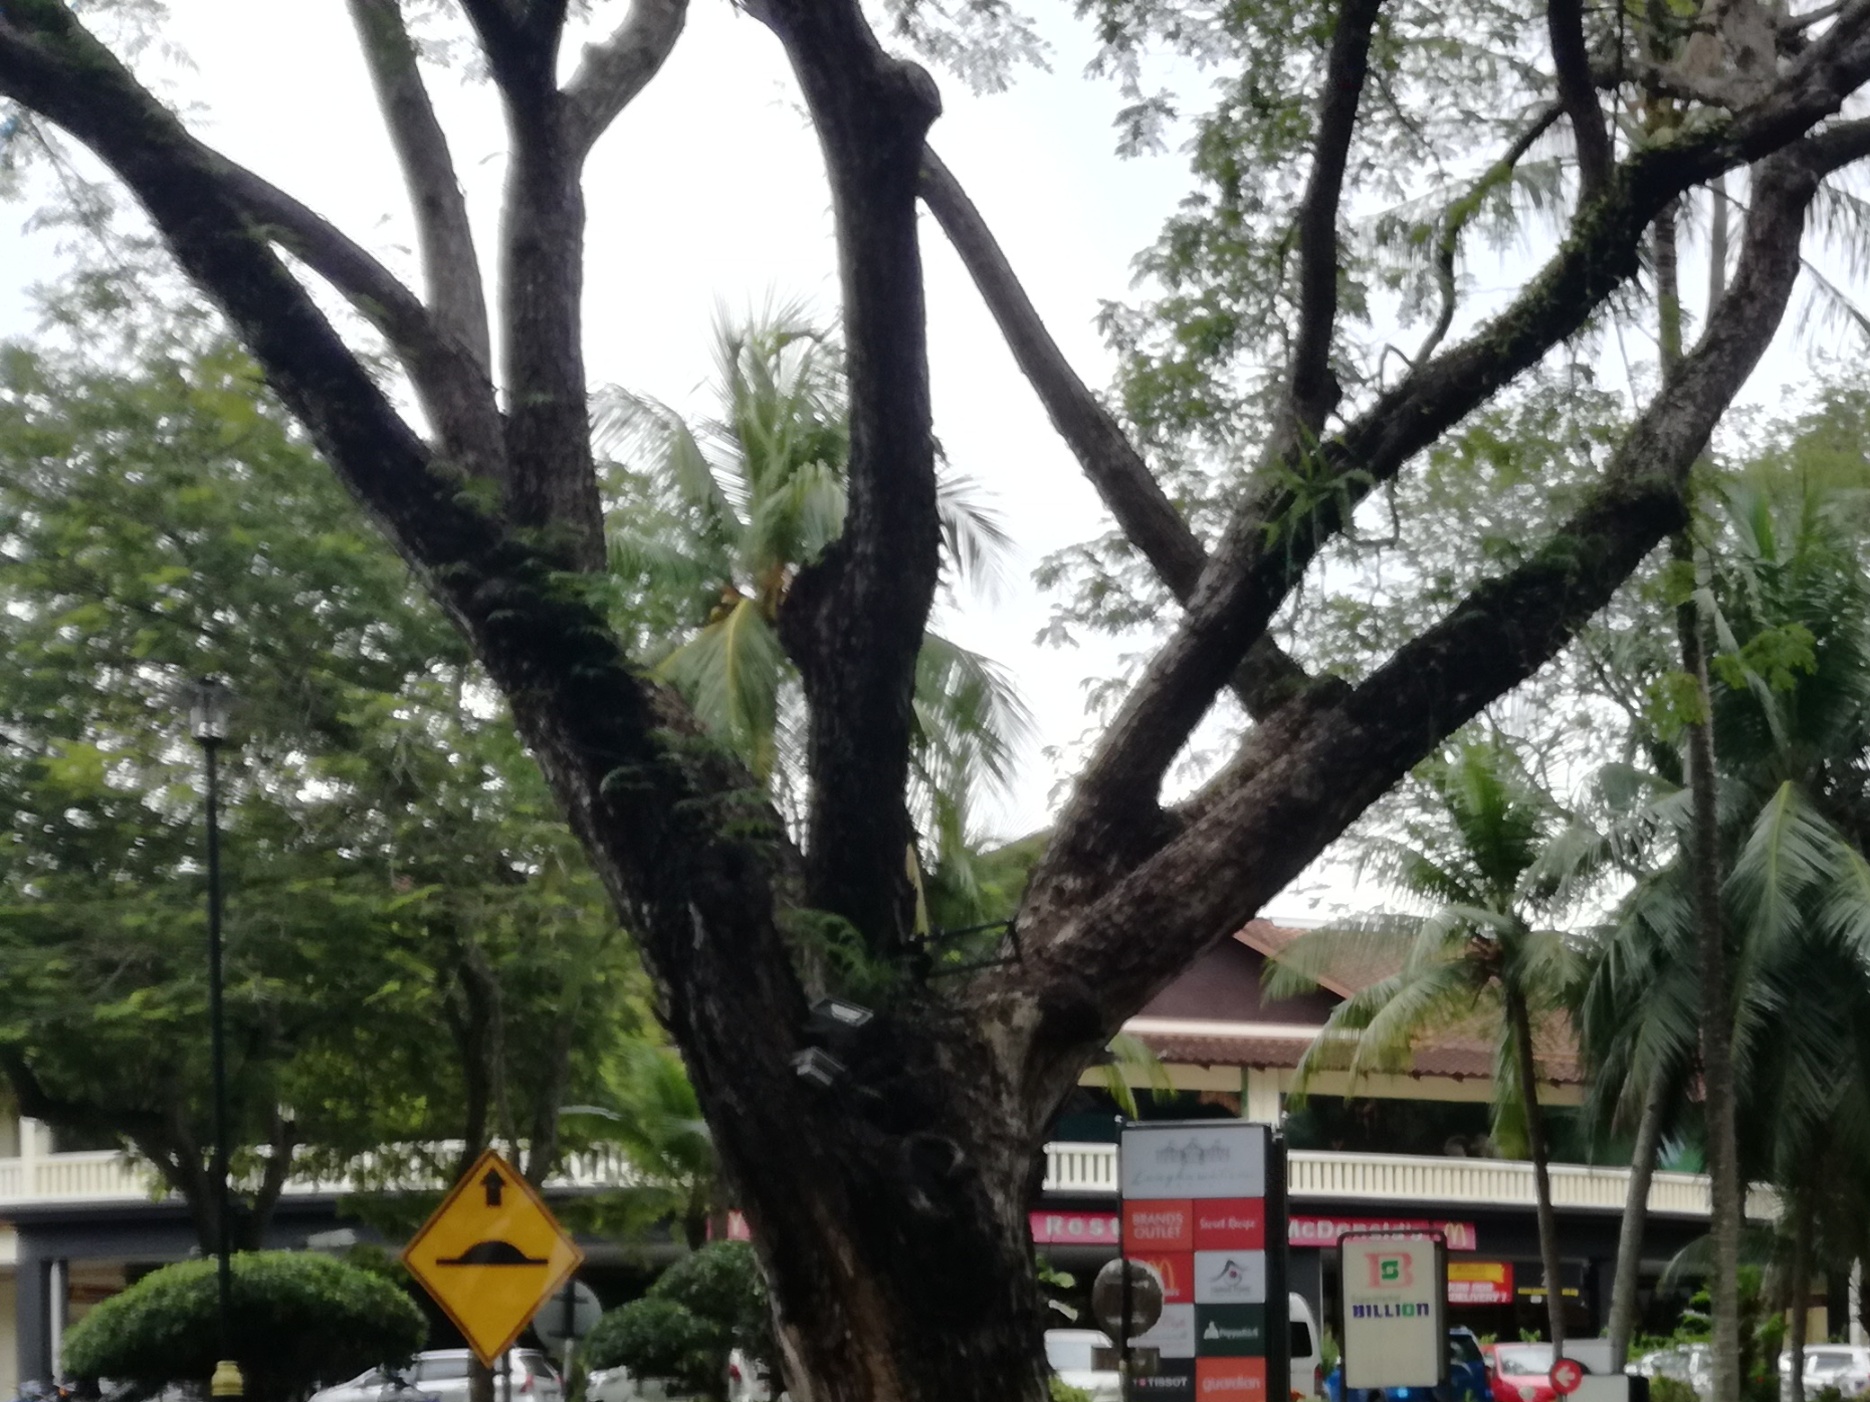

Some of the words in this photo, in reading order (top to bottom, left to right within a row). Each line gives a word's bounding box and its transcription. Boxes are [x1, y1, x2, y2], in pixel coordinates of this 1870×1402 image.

[1132, 1212, 1184, 1226] BRANDS
[1133, 1226, 1181, 1239] OUTLET
[1147, 1376, 1188, 1388] TISSOT
